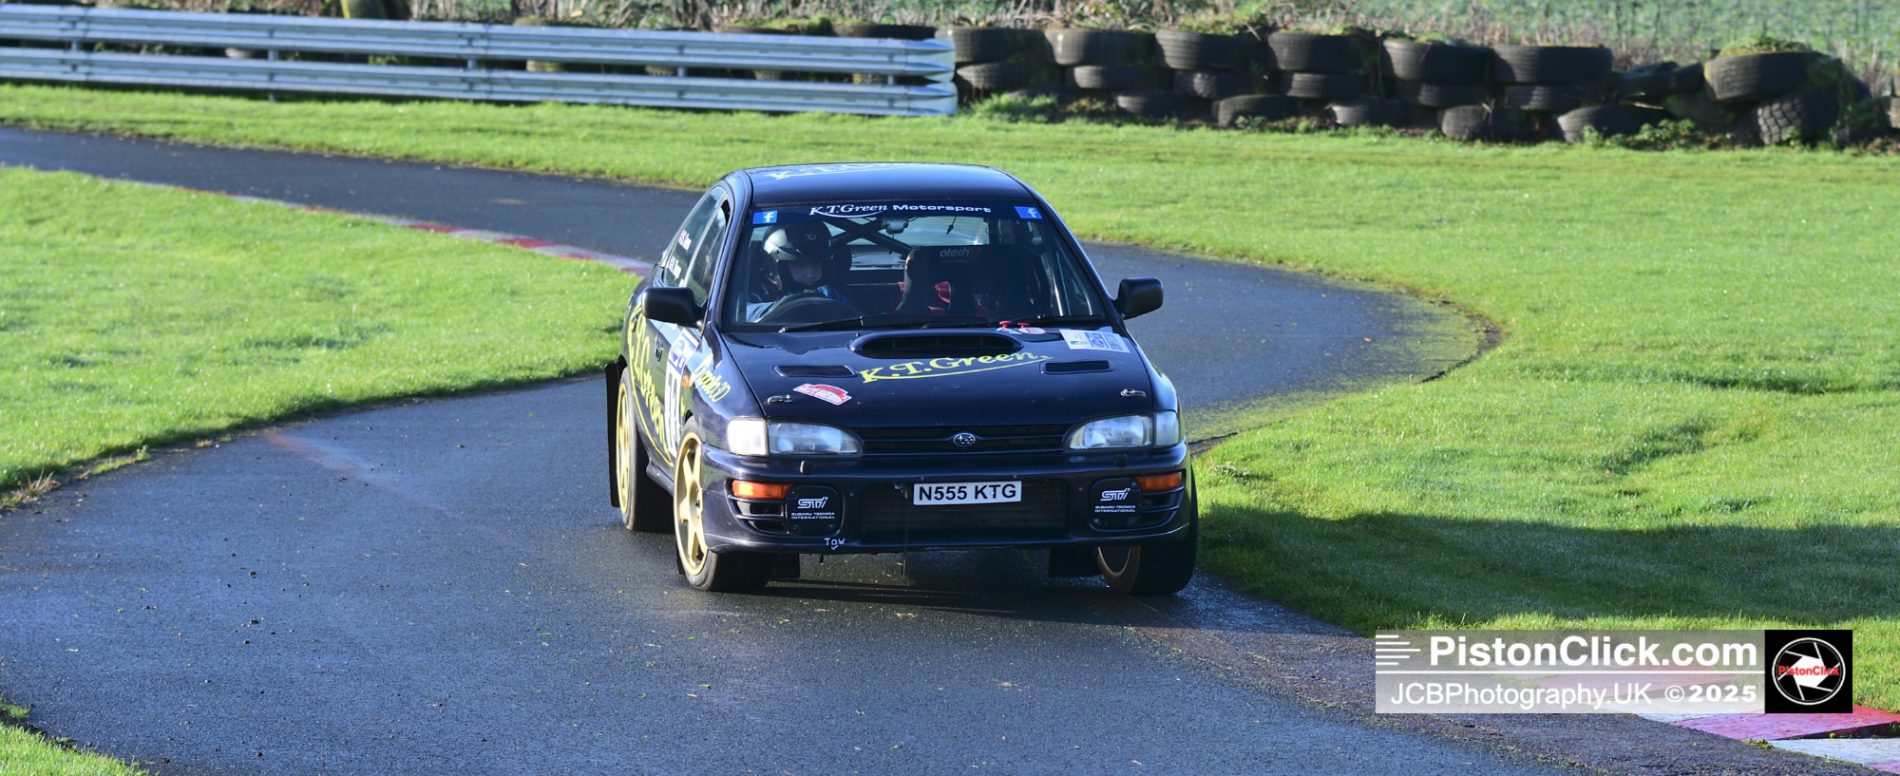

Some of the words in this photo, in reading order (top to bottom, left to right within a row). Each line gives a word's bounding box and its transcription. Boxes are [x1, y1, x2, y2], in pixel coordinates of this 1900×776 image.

[893, 204, 991, 213] Motorsport
[919, 485, 968, 501] N555
[974, 483, 1016, 500] KTG
